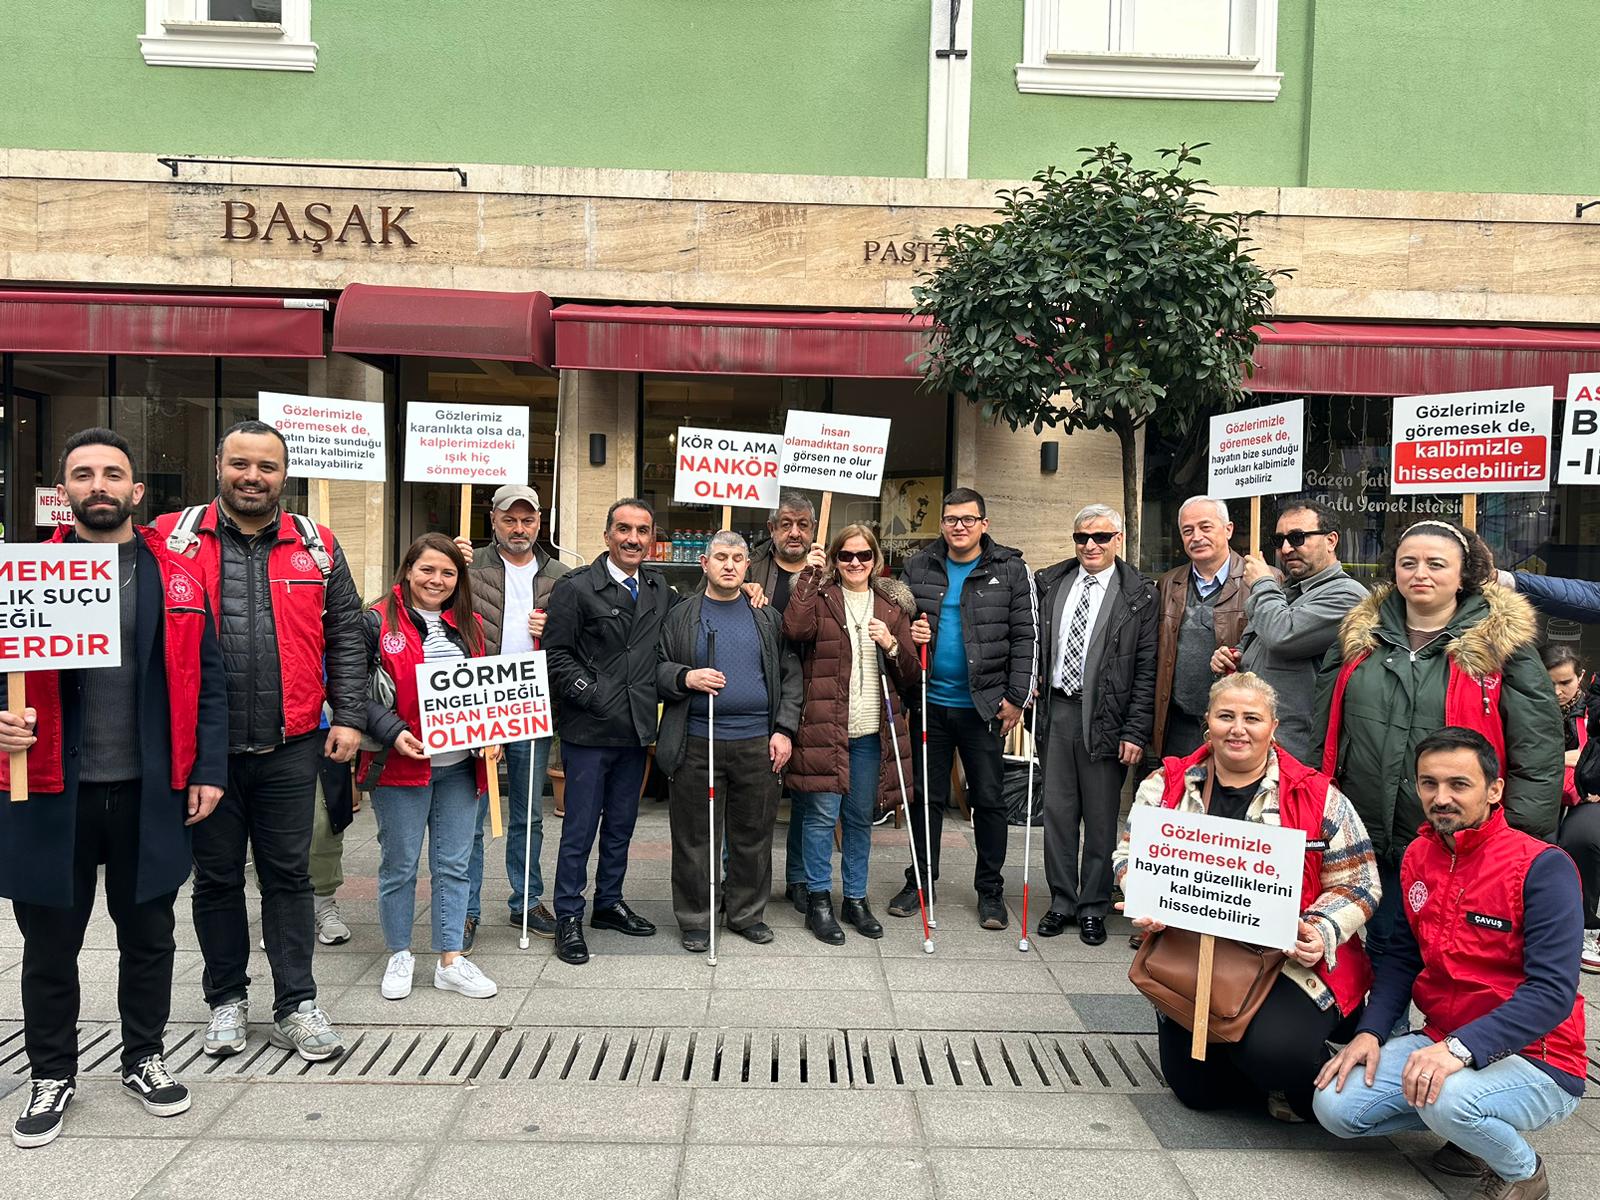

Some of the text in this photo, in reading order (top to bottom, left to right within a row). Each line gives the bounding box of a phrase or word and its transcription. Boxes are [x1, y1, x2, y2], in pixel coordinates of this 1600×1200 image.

[220, 200, 418, 253] BAŞAK
[282, 404, 363, 421] Gözlerimizle
[435, 409, 503, 423] Gözlerimiz
[1415, 399, 1526, 419] Gözlerimizle
[275, 418, 371, 436] göremesek de,
[410, 422, 525, 438] karanlıkta olsa da,
[821, 423, 851, 438] İnsan
[1225, 414, 1286, 435] Gözlerimizle
[1405, 418, 1536, 441] göremesek de,
[308, 434, 331, 445] bize
[333, 437, 382, 449] sunduğu
[419, 437, 516, 450] kalplerimizdeki
[681, 434, 778, 455] KÖR OL AMA
[784, 435, 885, 455] olamadıktan sonra
[1219, 429, 1291, 453] göremesek de,
[1415, 438, 1524, 459] kalbimizle
[320, 447, 376, 459] kalbimizle
[445, 452, 491, 464] ışık hiç
[792, 450, 873, 467] görsen ne olur
[1211, 443, 1300, 465] hayatın bize sunduğu
[426, 464, 507, 478] sönmeyecek
[679, 454, 778, 478] NANKÖR
[783, 461, 879, 481] görmesen ne olur
[1213, 456, 1296, 476] zorlukları kalbimizle
[1399, 461, 1542, 481] hissedebiliriz
[1234, 472, 1273, 487] aşabiliriz
[694, 480, 760, 501] OLMA
[1356, 496, 1408, 513] Yemek
[0, 587, 112, 607] IK SUÇU
[429, 660, 537, 692] GÖRME
[424, 683, 545, 712] ENGELİ DEĞİL
[428, 714, 549, 749] OLMASIN
[1161, 823, 1273, 854] Gözlerimizle
[1148, 843, 1281, 880] göremesek de,
[1135, 857, 1293, 898] hayatın güzelliklerini
[1170, 881, 1252, 908] kalbimizde
[1159, 895, 1261, 928] hissedebiliriz
[1474, 915, 1503, 928] ÇAVUŞ
